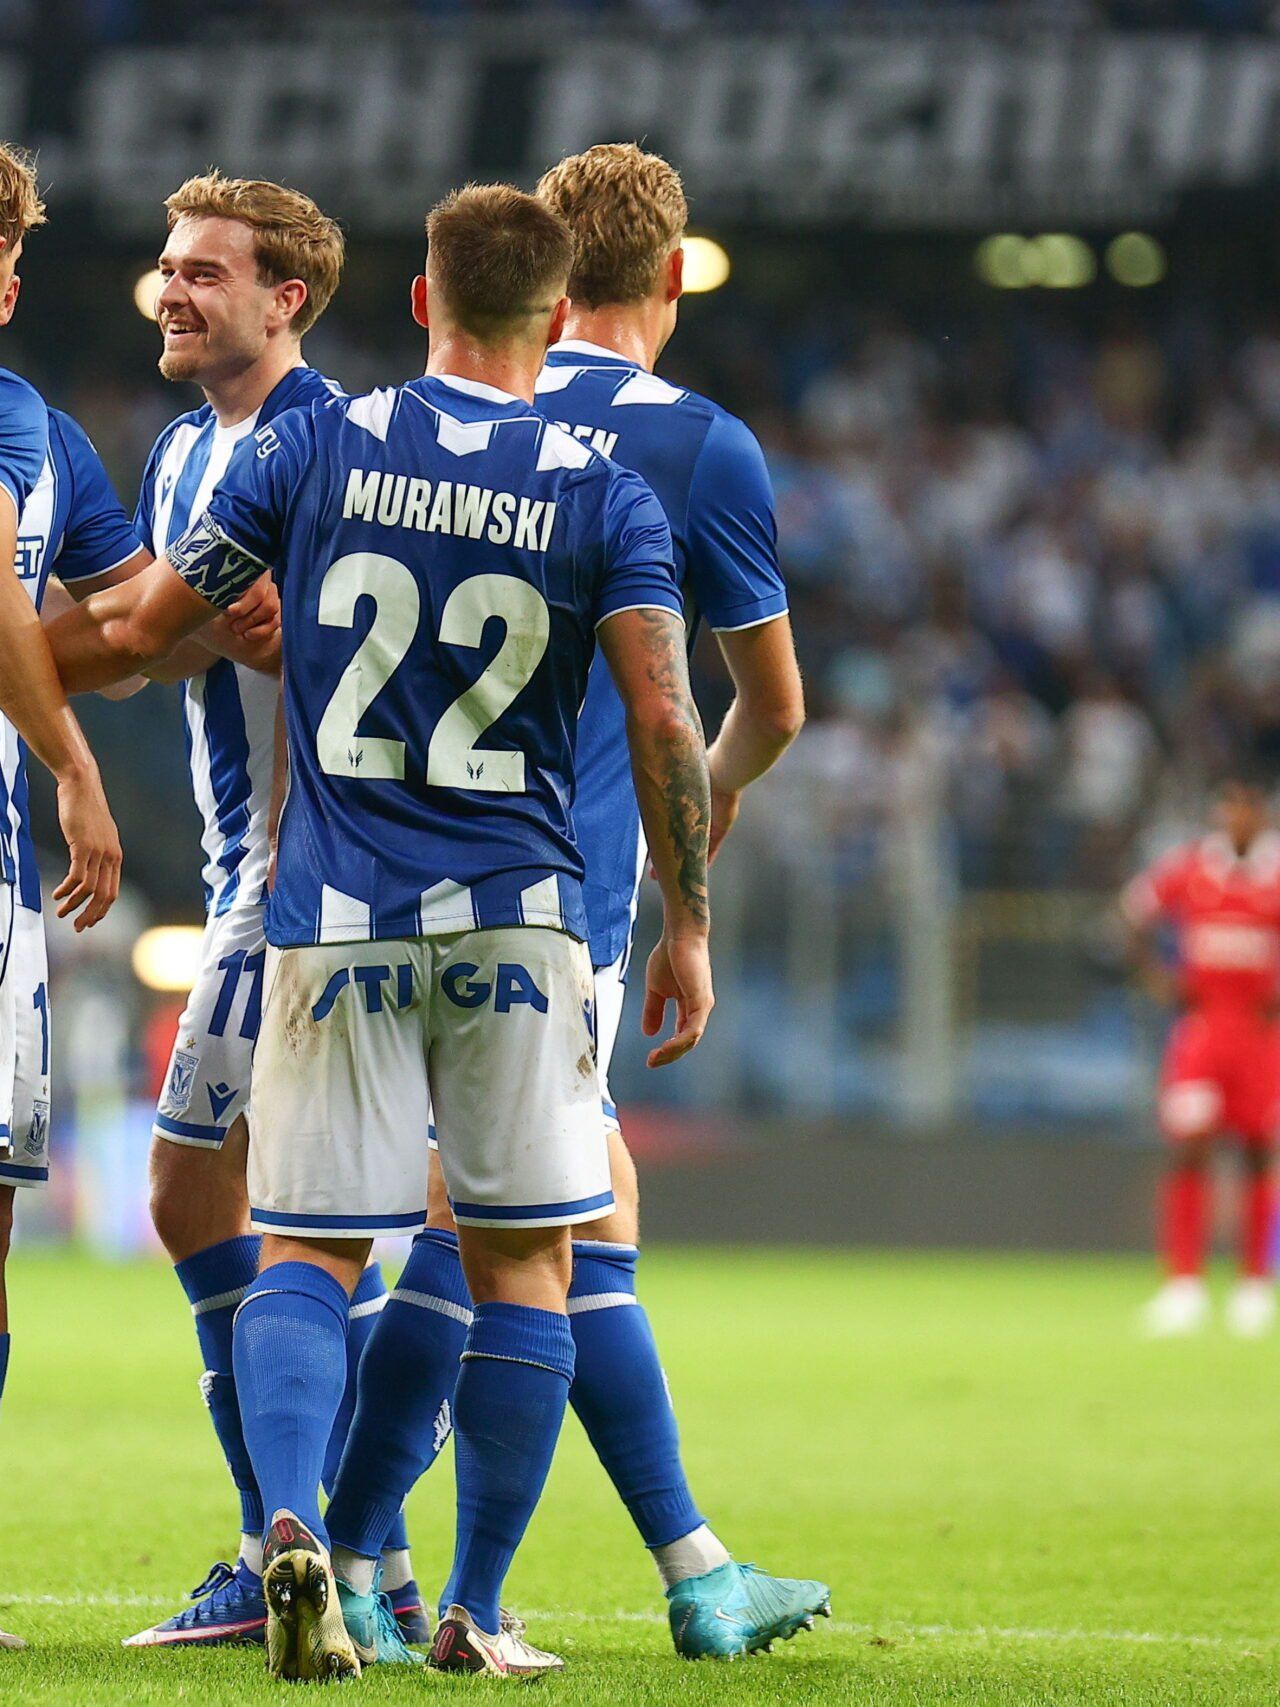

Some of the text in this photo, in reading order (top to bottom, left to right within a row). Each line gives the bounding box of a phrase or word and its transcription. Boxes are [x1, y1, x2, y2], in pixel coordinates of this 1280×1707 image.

[342, 468, 557, 553] MURAWSKI
[316, 551, 551, 793] 22
[207, 949, 265, 1040] 11
